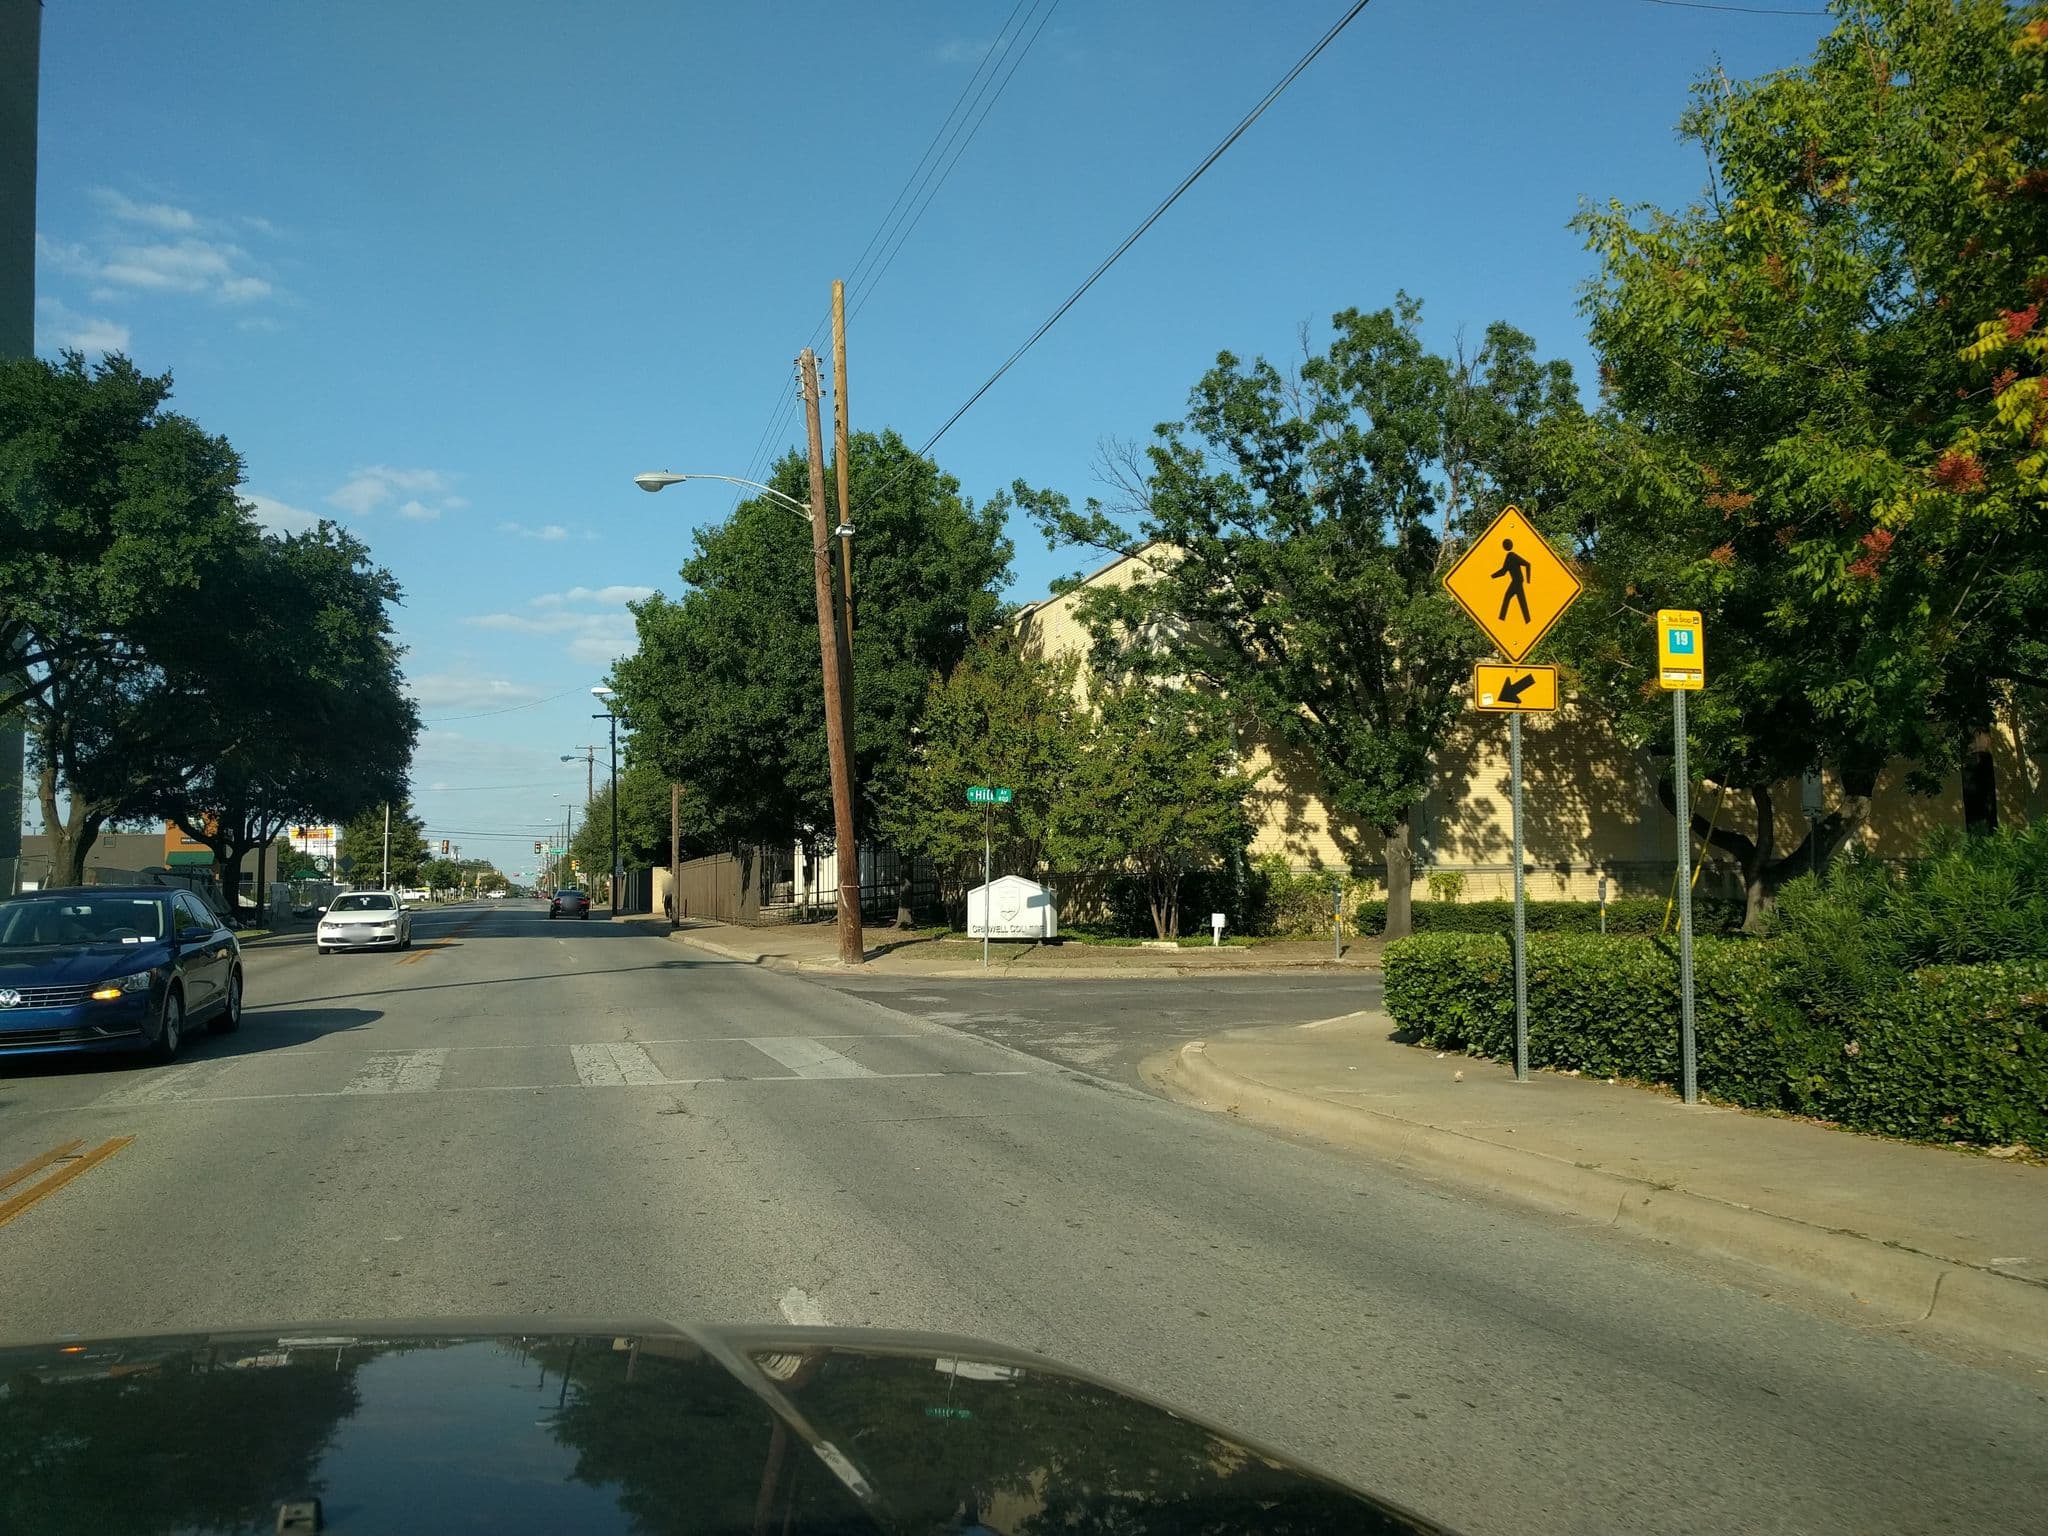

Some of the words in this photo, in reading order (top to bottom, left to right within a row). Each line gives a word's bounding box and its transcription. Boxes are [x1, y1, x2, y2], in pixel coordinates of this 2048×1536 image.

[1674, 631, 1688, 646] 19
[975, 789, 994, 801] Hill
[972, 925, 1009, 934] CRWELL
